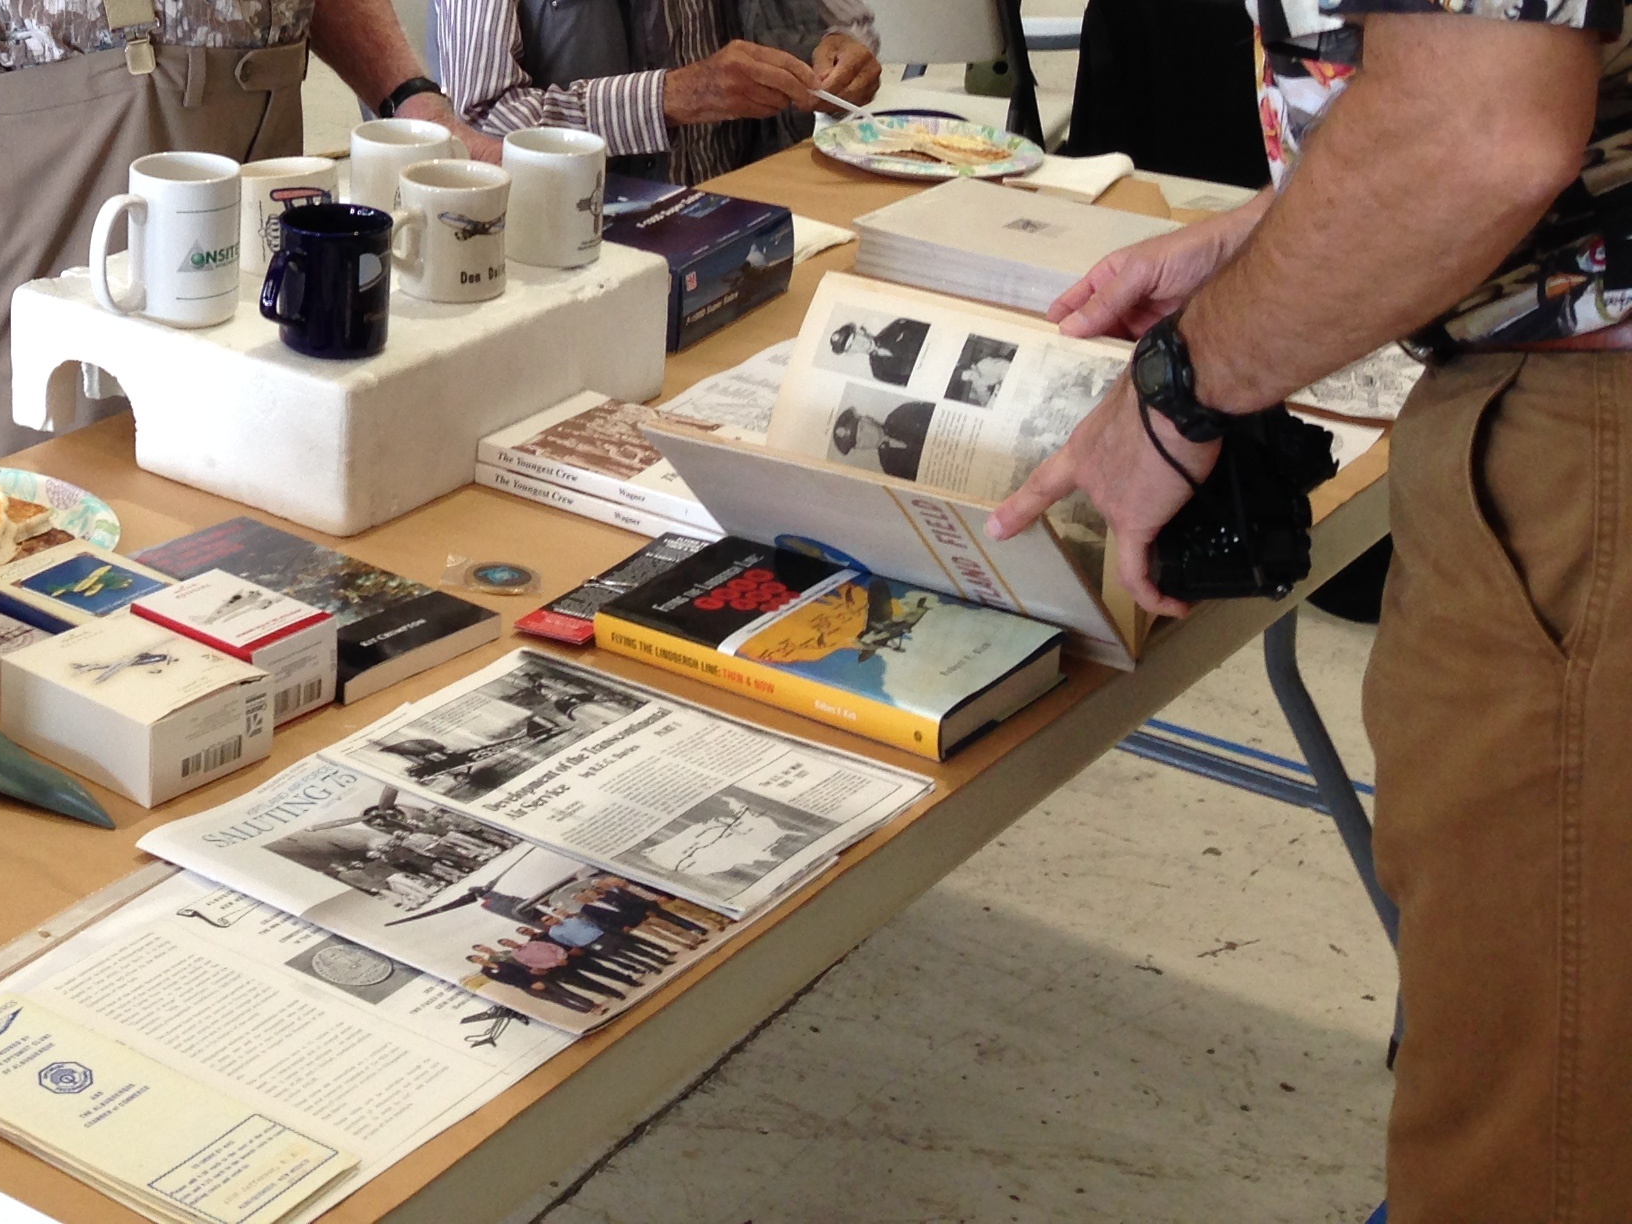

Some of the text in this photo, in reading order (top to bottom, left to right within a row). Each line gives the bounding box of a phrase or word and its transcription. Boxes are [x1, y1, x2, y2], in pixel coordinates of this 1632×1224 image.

[494, 473, 641, 526] The Youngest Crew Wagner
[497, 451, 646, 503] The Youngest Crew Wagner
[911, 498, 969, 550] FIELD
[610, 631, 638, 650] FLYING
[639, 640, 654, 656] THE
[483, 706, 673, 812] Development of the Transcontinental
[202, 769, 358, 848] SALUTING 75
[505, 782, 571, 821] Air Service
